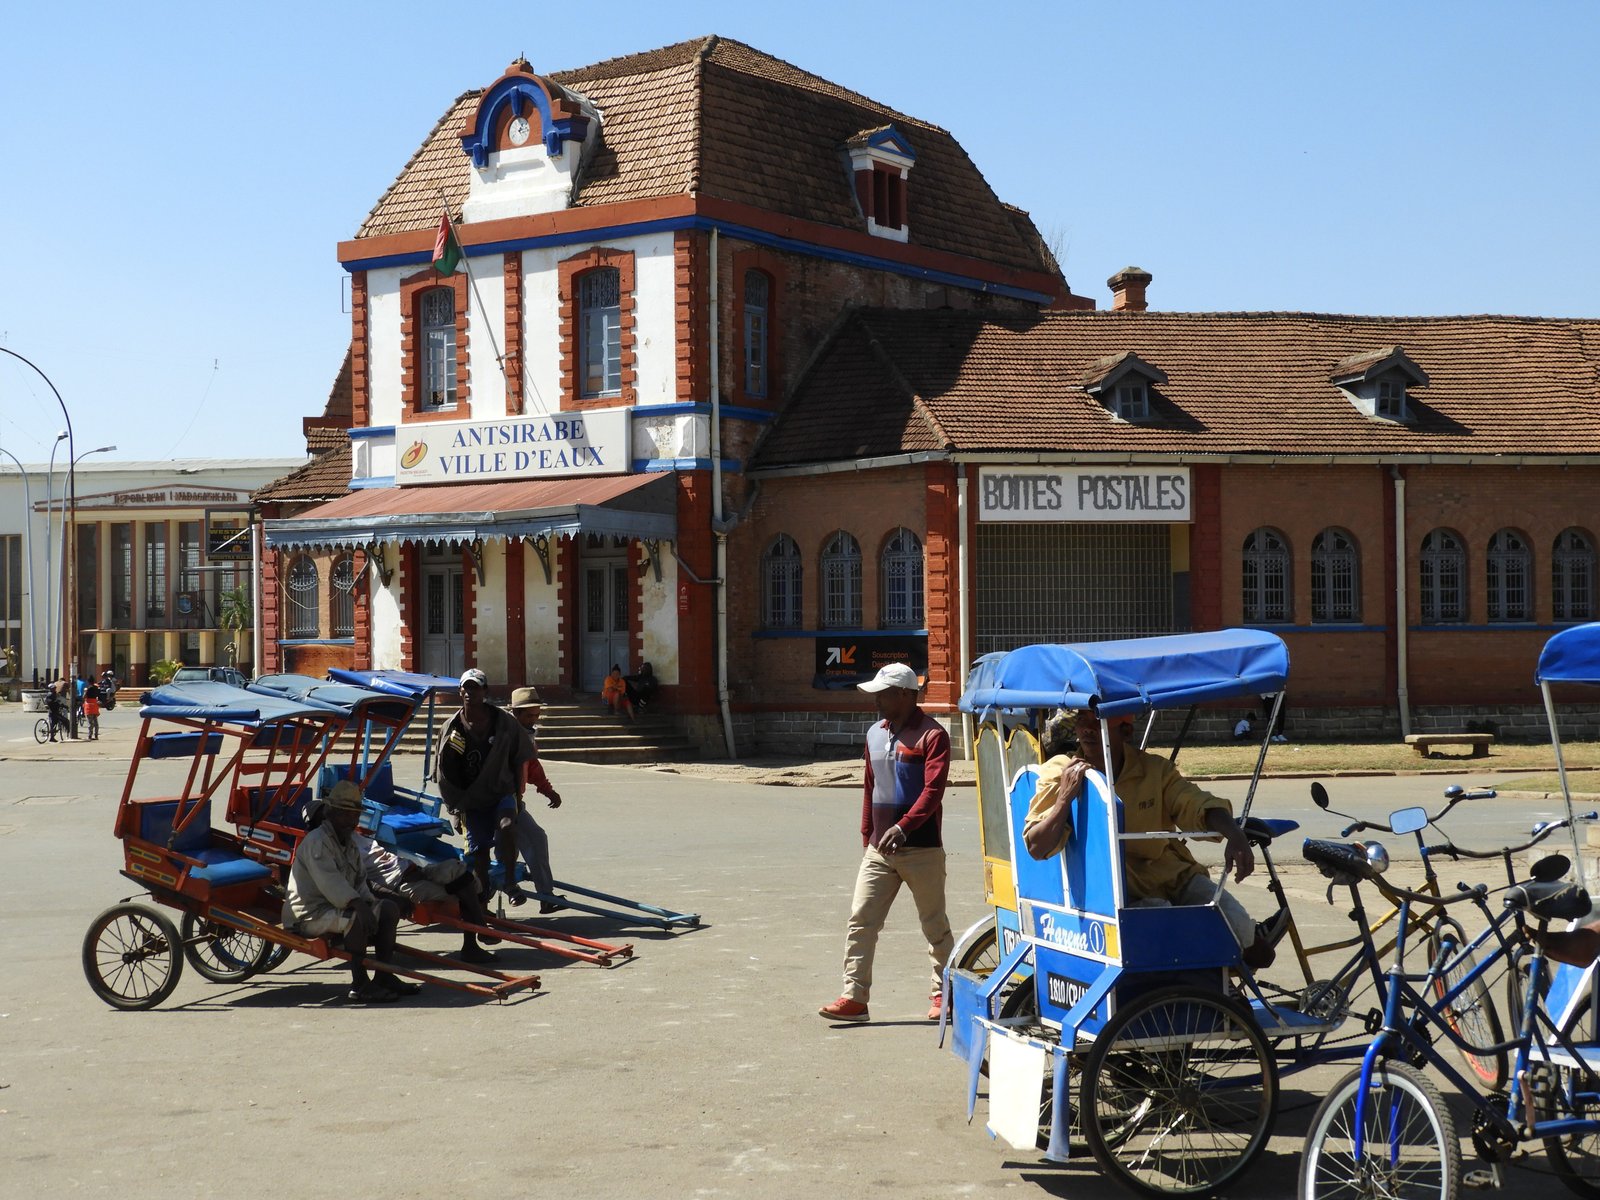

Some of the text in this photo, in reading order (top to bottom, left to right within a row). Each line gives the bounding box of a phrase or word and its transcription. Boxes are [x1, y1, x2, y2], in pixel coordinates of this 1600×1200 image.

[452, 419, 584, 448] ANTSIRABE
[439, 451, 507, 475] VILLE
[982, 474, 1186, 511] BOITES POSTALES
